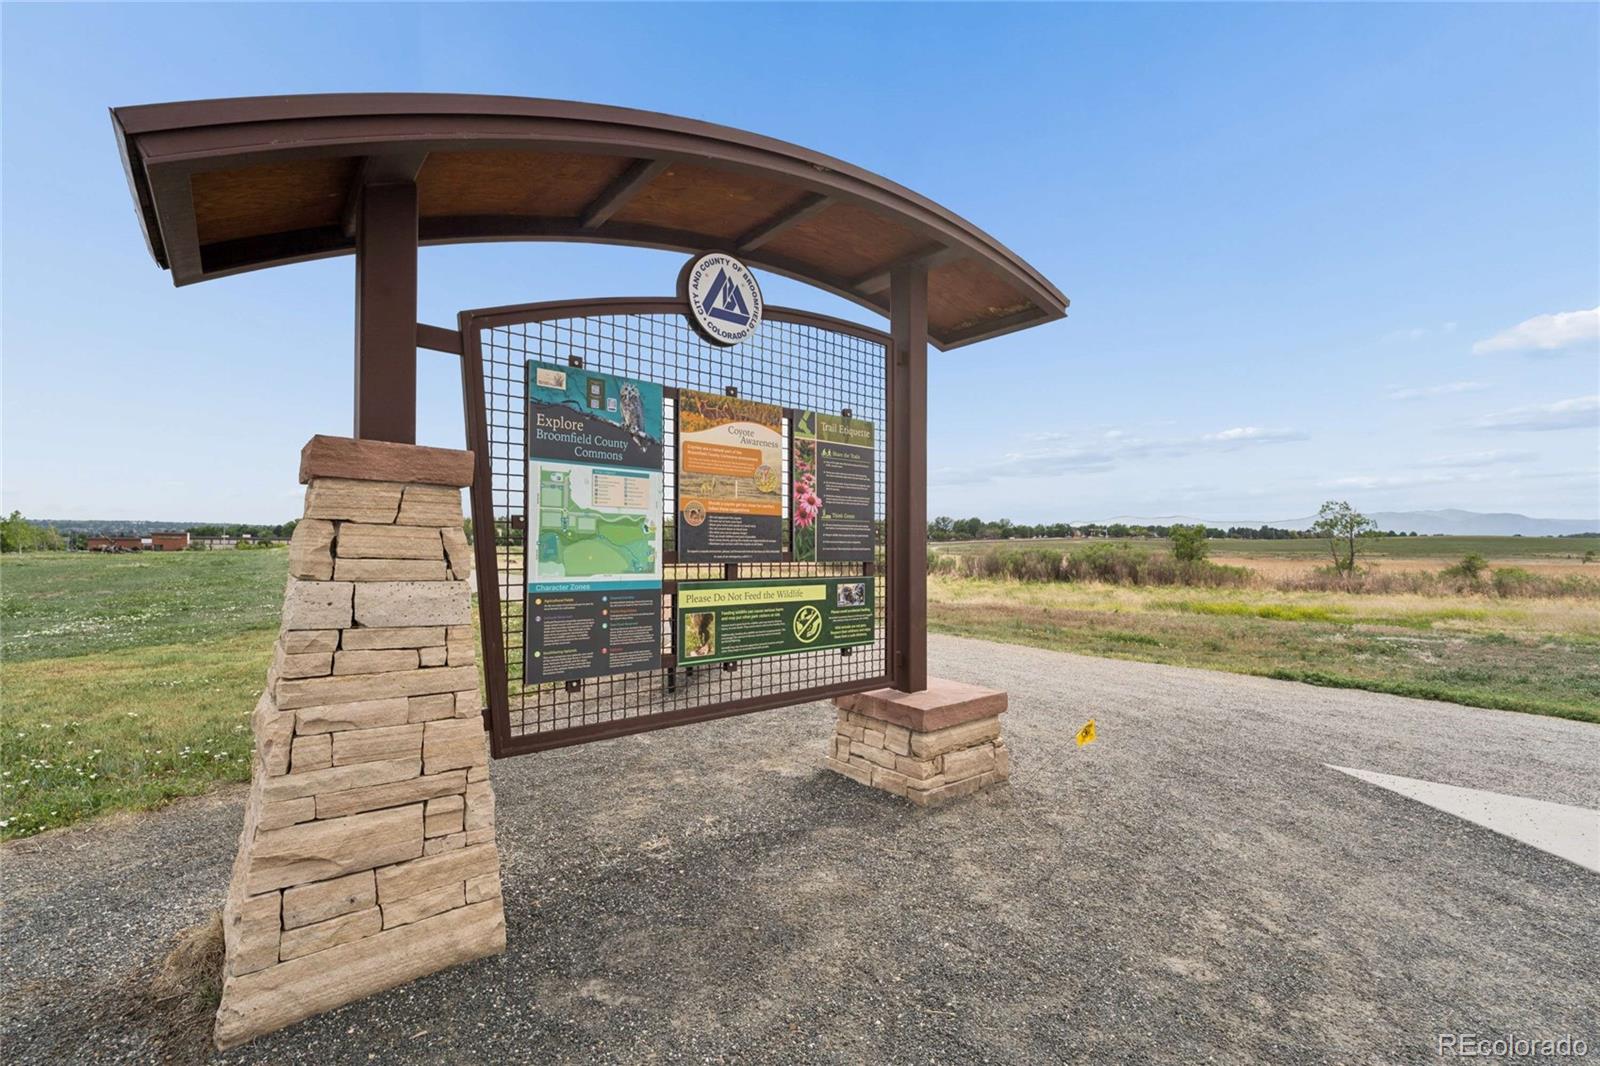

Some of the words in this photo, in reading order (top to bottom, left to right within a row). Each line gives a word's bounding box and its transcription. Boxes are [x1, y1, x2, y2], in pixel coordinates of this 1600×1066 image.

[700, 257, 730, 271] COUNTY
[732, 263, 743, 273] OF
[692, 270, 703, 291] AND
[692, 292, 704, 316] CITY
[742, 273, 760, 329] BROOMFIELD
[707, 321, 748, 340] COLORADO
[536, 413, 584, 431] Explore
[821, 422, 837, 433] Trail
[536, 428, 592, 445] Broomfield
[594, 435, 629, 449] County
[727, 425, 756, 437] Coyote
[740, 437, 779, 449] Awareness
[574, 446, 623, 461] Commons
[536, 583, 569, 592] Character
[570, 583, 591, 591] Zones
[685, 593, 712, 604] Please
[713, 593, 726, 602] Do
[727, 592, 742, 602] Not
[744, 591, 762, 600] Feed
[763, 590, 775, 600] the
[777, 589, 804, 599] Wildlife
